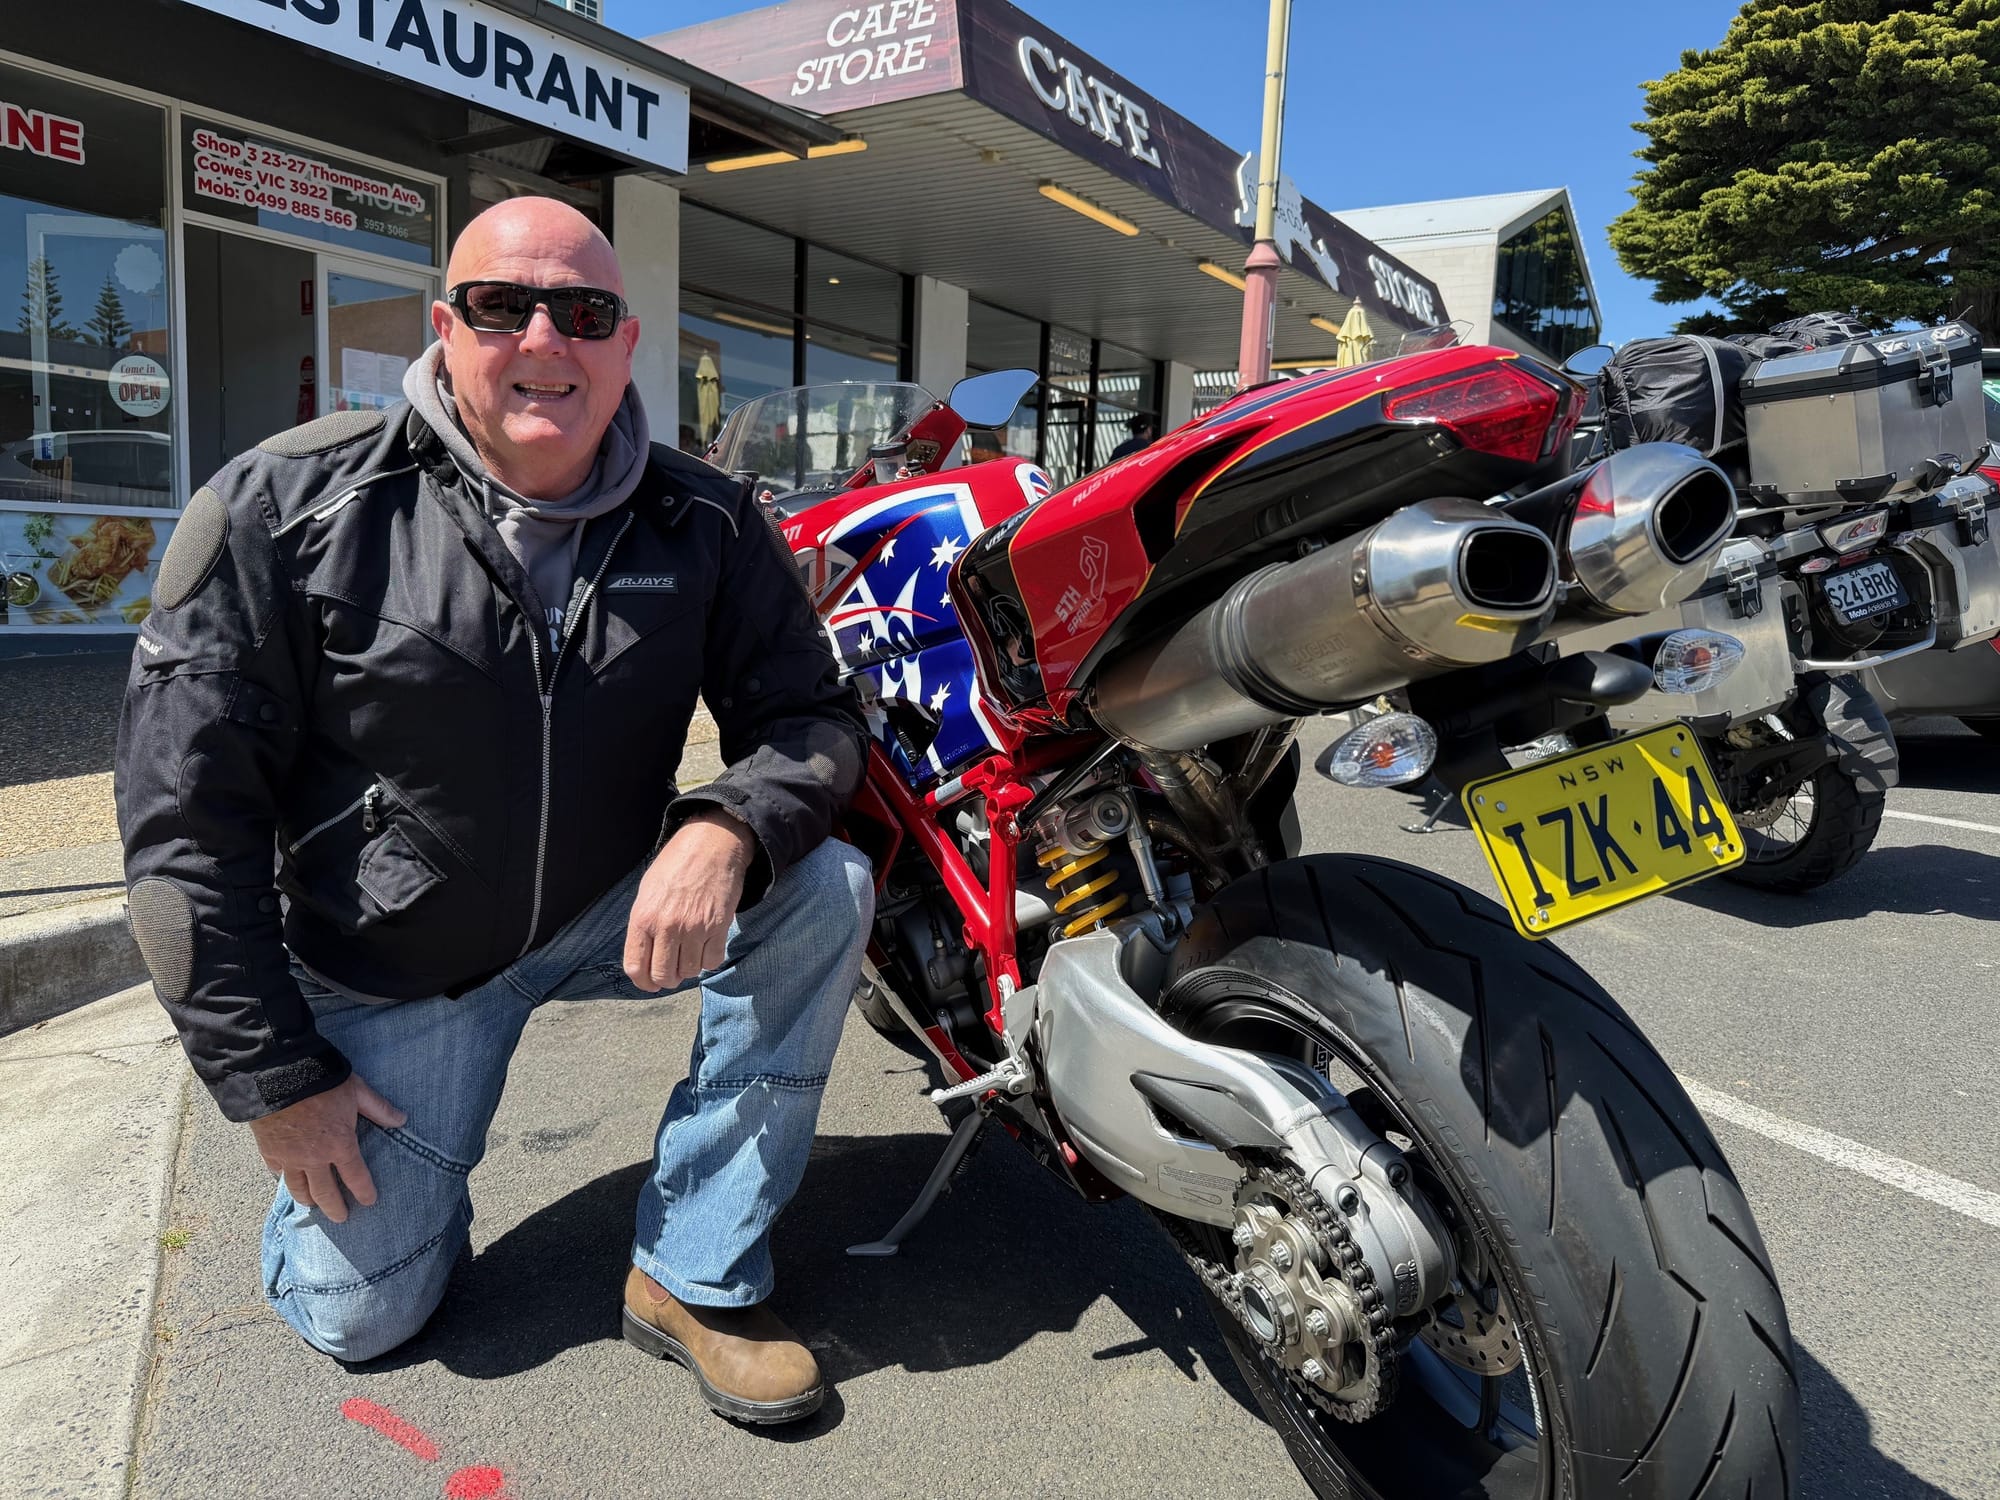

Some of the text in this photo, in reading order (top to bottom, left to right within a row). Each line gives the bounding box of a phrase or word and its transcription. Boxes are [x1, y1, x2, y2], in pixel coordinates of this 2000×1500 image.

[826, 0, 942, 47] CAFE
[791, 34, 933, 97] STORE
[1018, 36, 1162, 169] CAFE
[0, 106, 81, 161] NE
[197, 132, 422, 208] Shop 3 23-27 Thompson Ave,
[197, 156, 328, 201] Cowes VIC 3922
[198, 176, 353, 228] Mob: 0499 885 566
[364, 218, 385, 233] 5952
[1368, 255, 1440, 327] STORE
[120, 363, 156, 374] Come in
[119, 381, 161, 402] OPEN
[1849, 571, 1861, 579] SA
[1054, 584, 1082, 623] 5TH
[1067, 598, 1094, 636] SPAIN
[1848, 600, 1892, 619] Moto Adelaide
[1557, 756, 1624, 791] NSW
